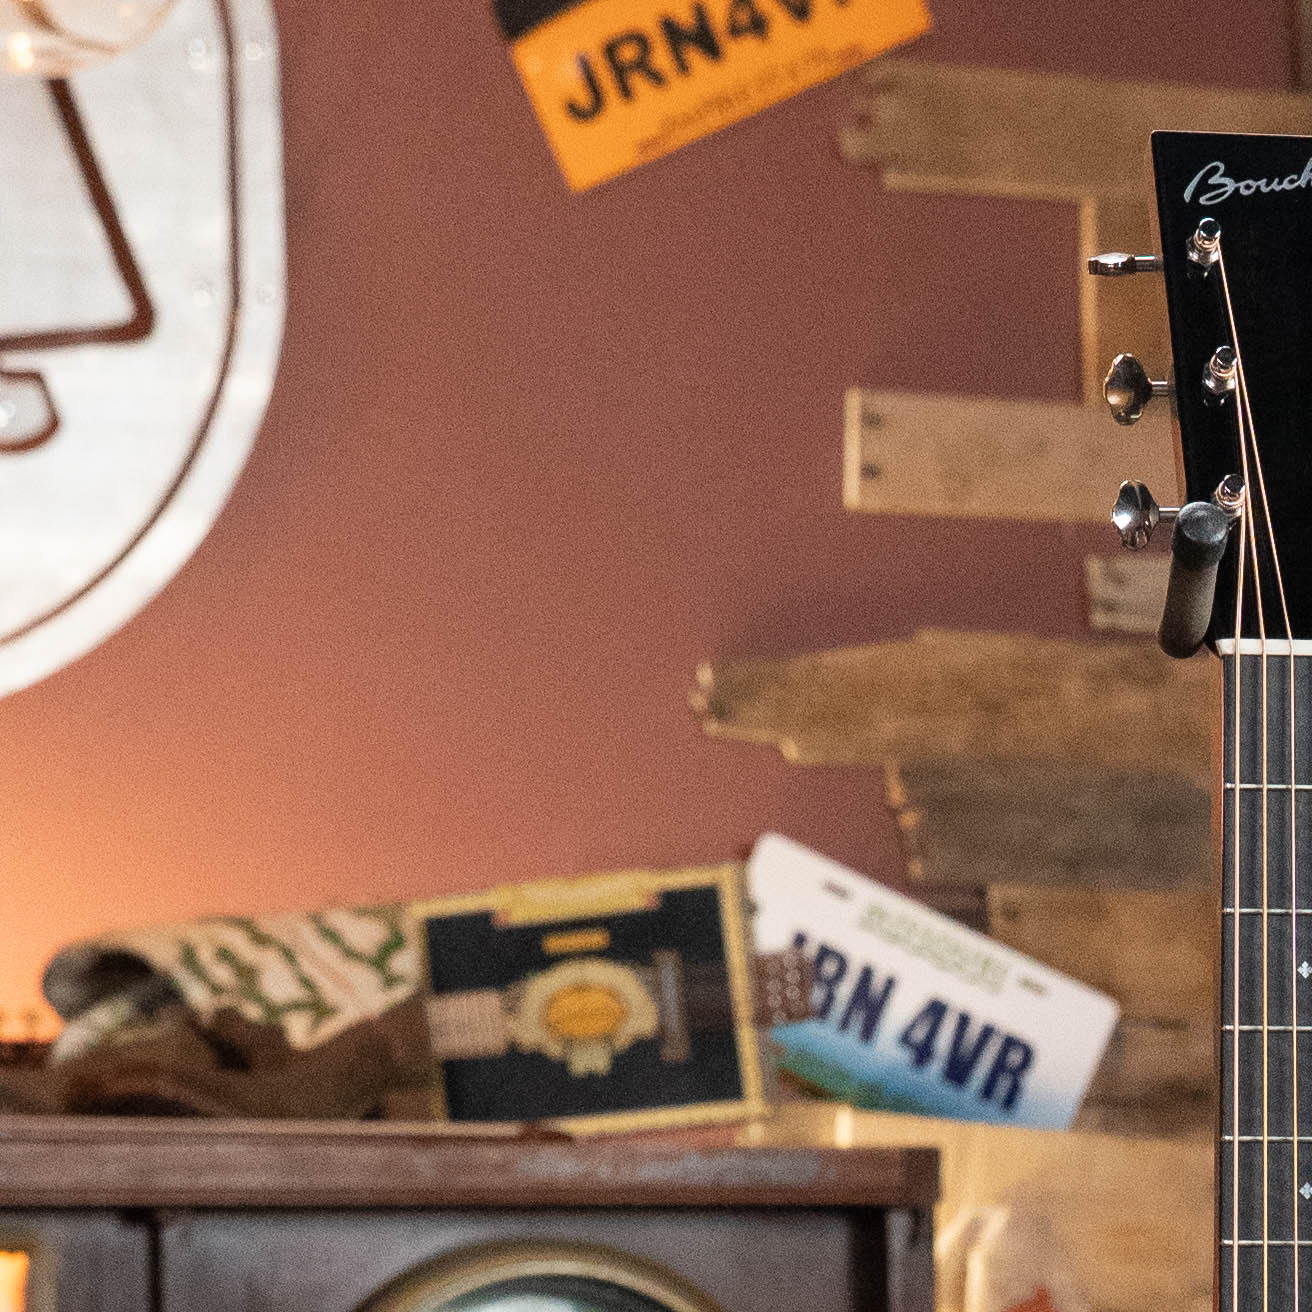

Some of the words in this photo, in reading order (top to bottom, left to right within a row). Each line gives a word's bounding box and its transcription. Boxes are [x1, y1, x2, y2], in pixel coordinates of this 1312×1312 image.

[563, 0, 850, 122] JRN4
[791, 931, 898, 1044] RN
[898, 996, 1035, 1113] 4VR
